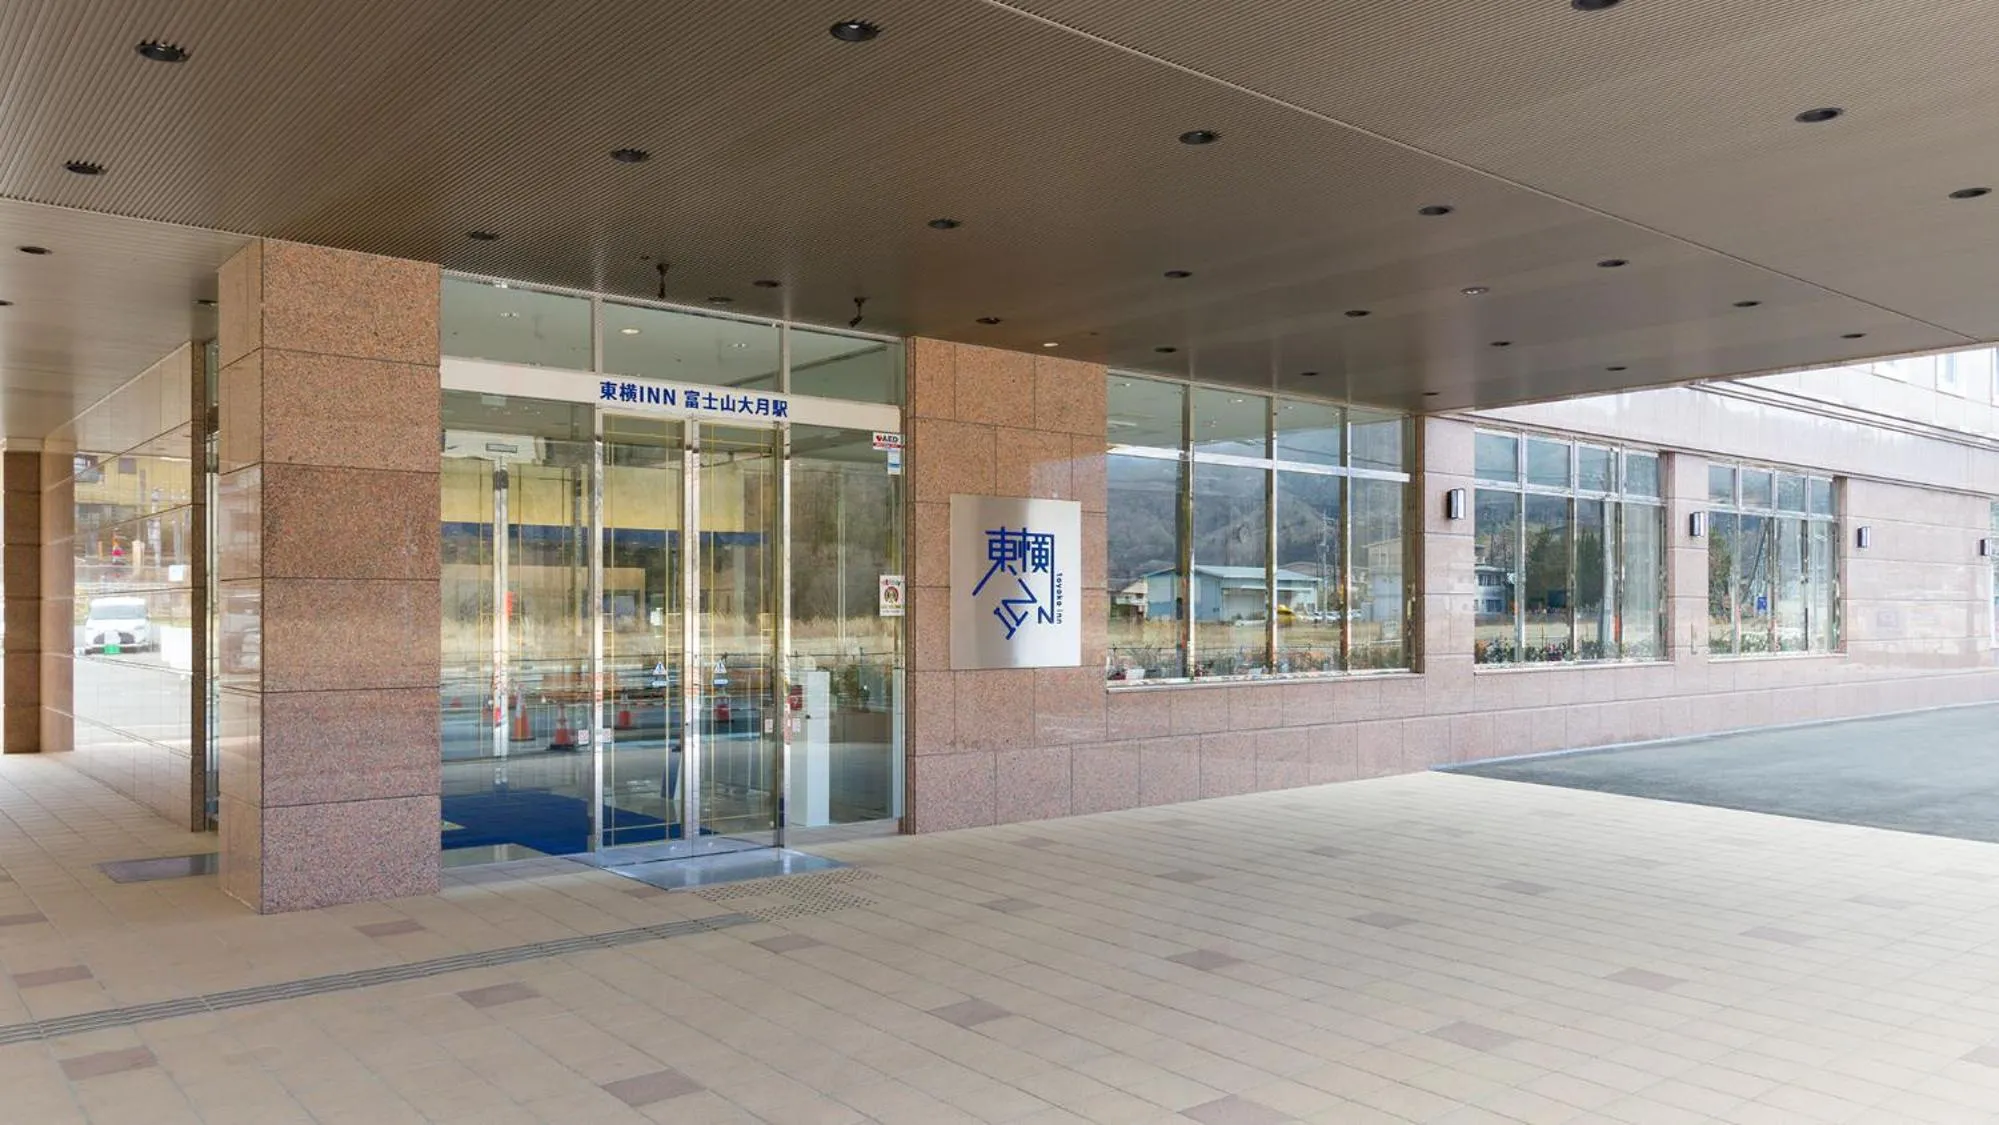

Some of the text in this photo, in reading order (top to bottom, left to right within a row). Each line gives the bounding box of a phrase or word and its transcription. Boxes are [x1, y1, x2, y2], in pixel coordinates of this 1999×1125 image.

[600, 381, 788, 418] 東横INN 富士山大月駅
[882, 435, 899, 443] AED
